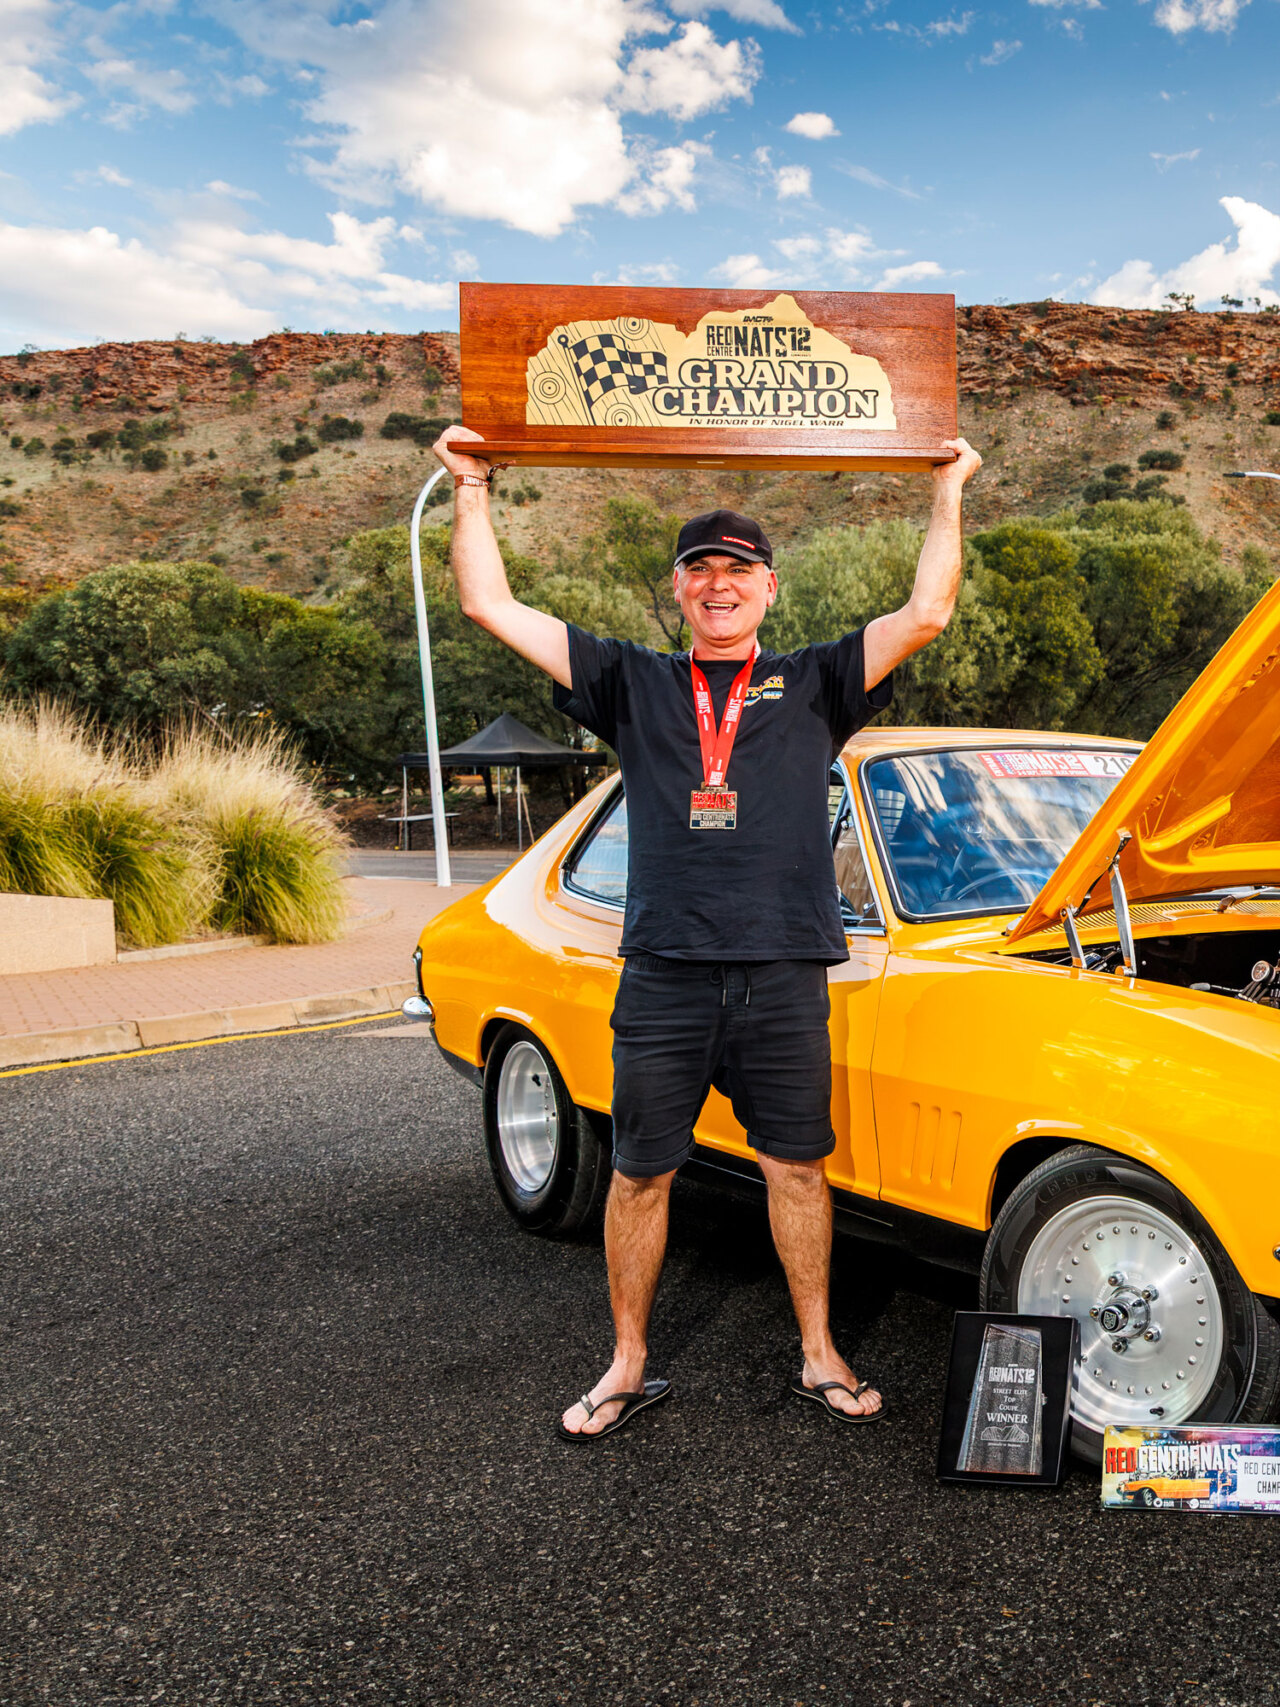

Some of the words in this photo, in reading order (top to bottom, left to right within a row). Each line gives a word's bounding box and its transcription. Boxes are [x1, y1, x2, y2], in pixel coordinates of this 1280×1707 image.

[706, 325, 733, 346] RED
[734, 326, 787, 357] NATS
[788, 327, 811, 351] 12
[706, 346, 733, 356] CENTRE
[678, 359, 849, 389] GRAND
[652, 387, 878, 418] CHAMPION
[707, 418, 749, 426] HONOR
[810, 419, 844, 427] WARR
[1000, 1367, 1025, 1383] NATS
[986, 1412, 1028, 1424] WINNER
[1105, 1446, 1137, 1474] RED
[1138, 1443, 1241, 1474] CENTRENATS
[1244, 1461, 1258, 1475] RED
